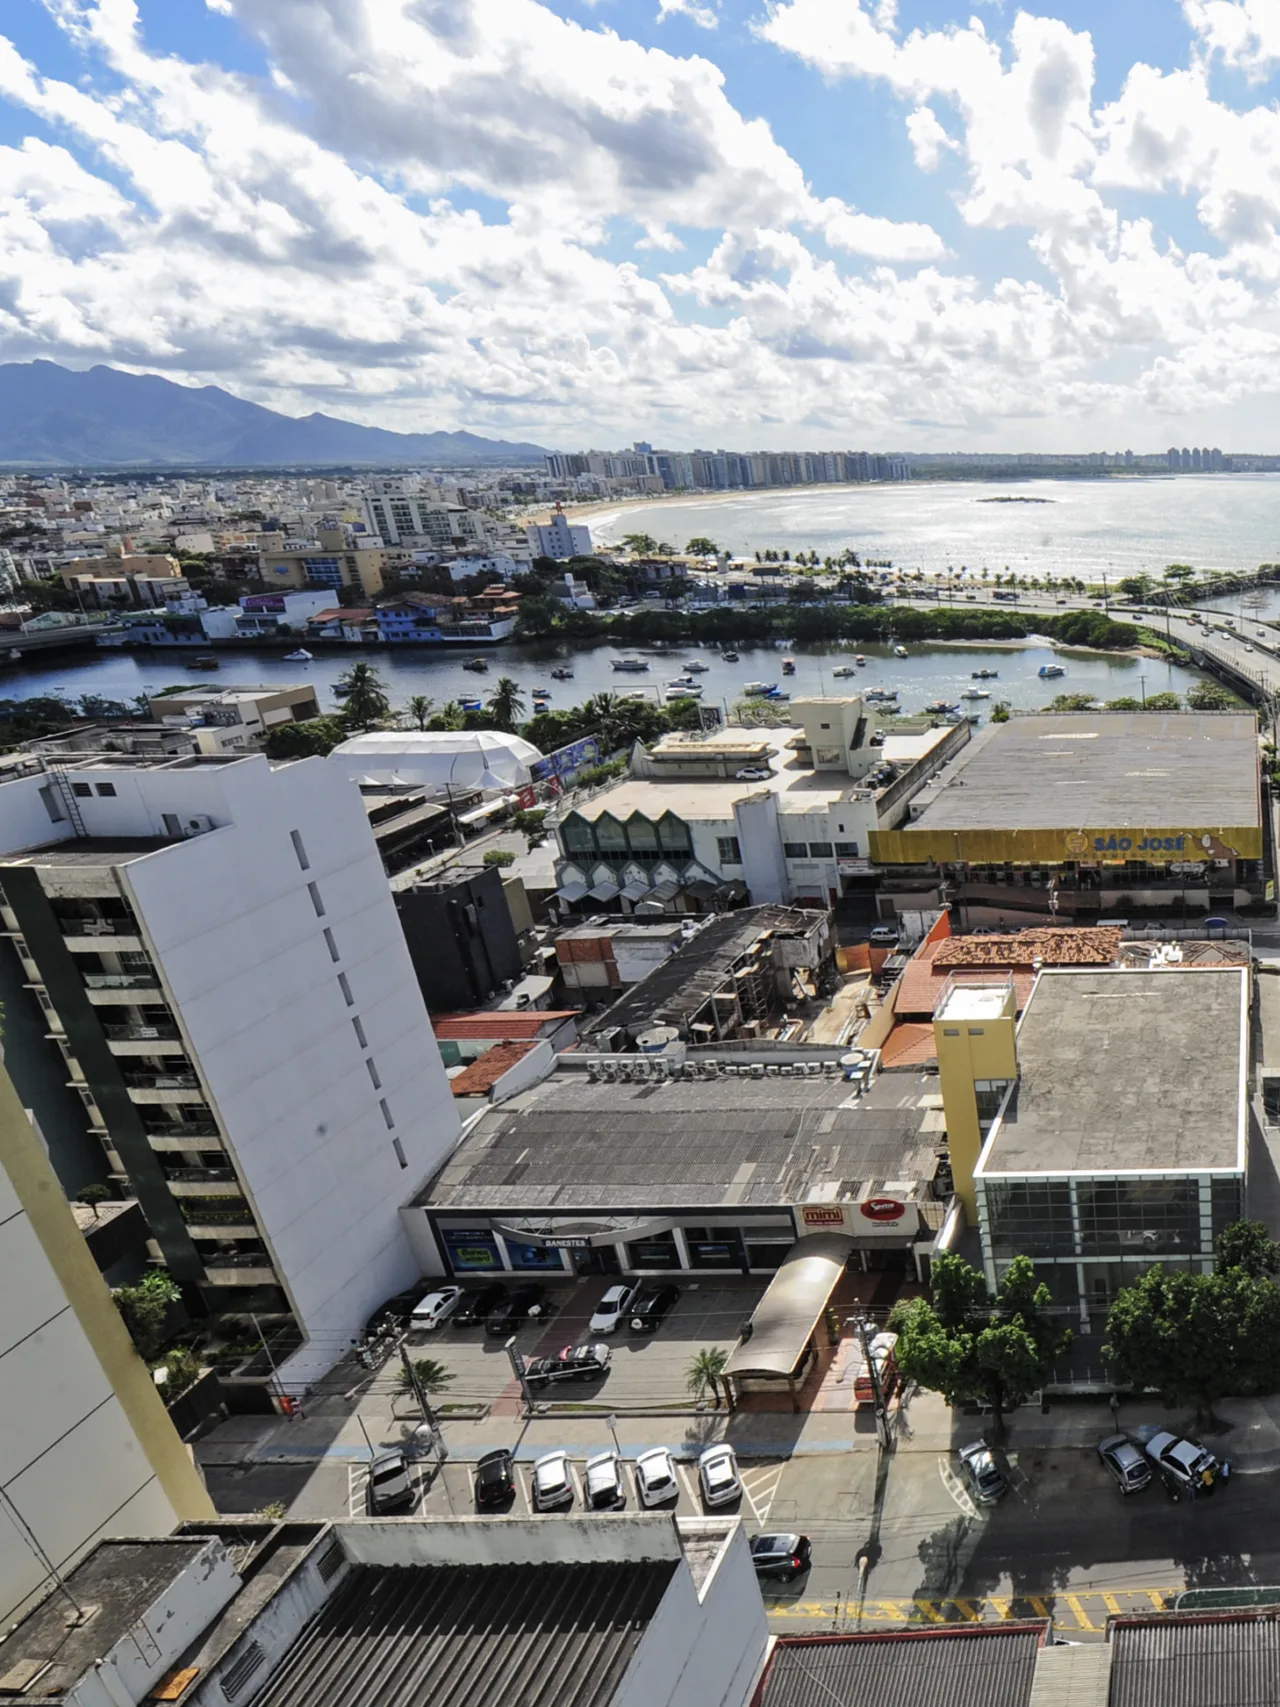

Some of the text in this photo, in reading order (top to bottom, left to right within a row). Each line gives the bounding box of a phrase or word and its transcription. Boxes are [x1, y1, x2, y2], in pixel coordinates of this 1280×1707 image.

[1094, 834, 1186, 851] SÃO JOSÉ
[805, 1208, 840, 1220] mimi
[545, 1239, 586, 1248] BANESTES
